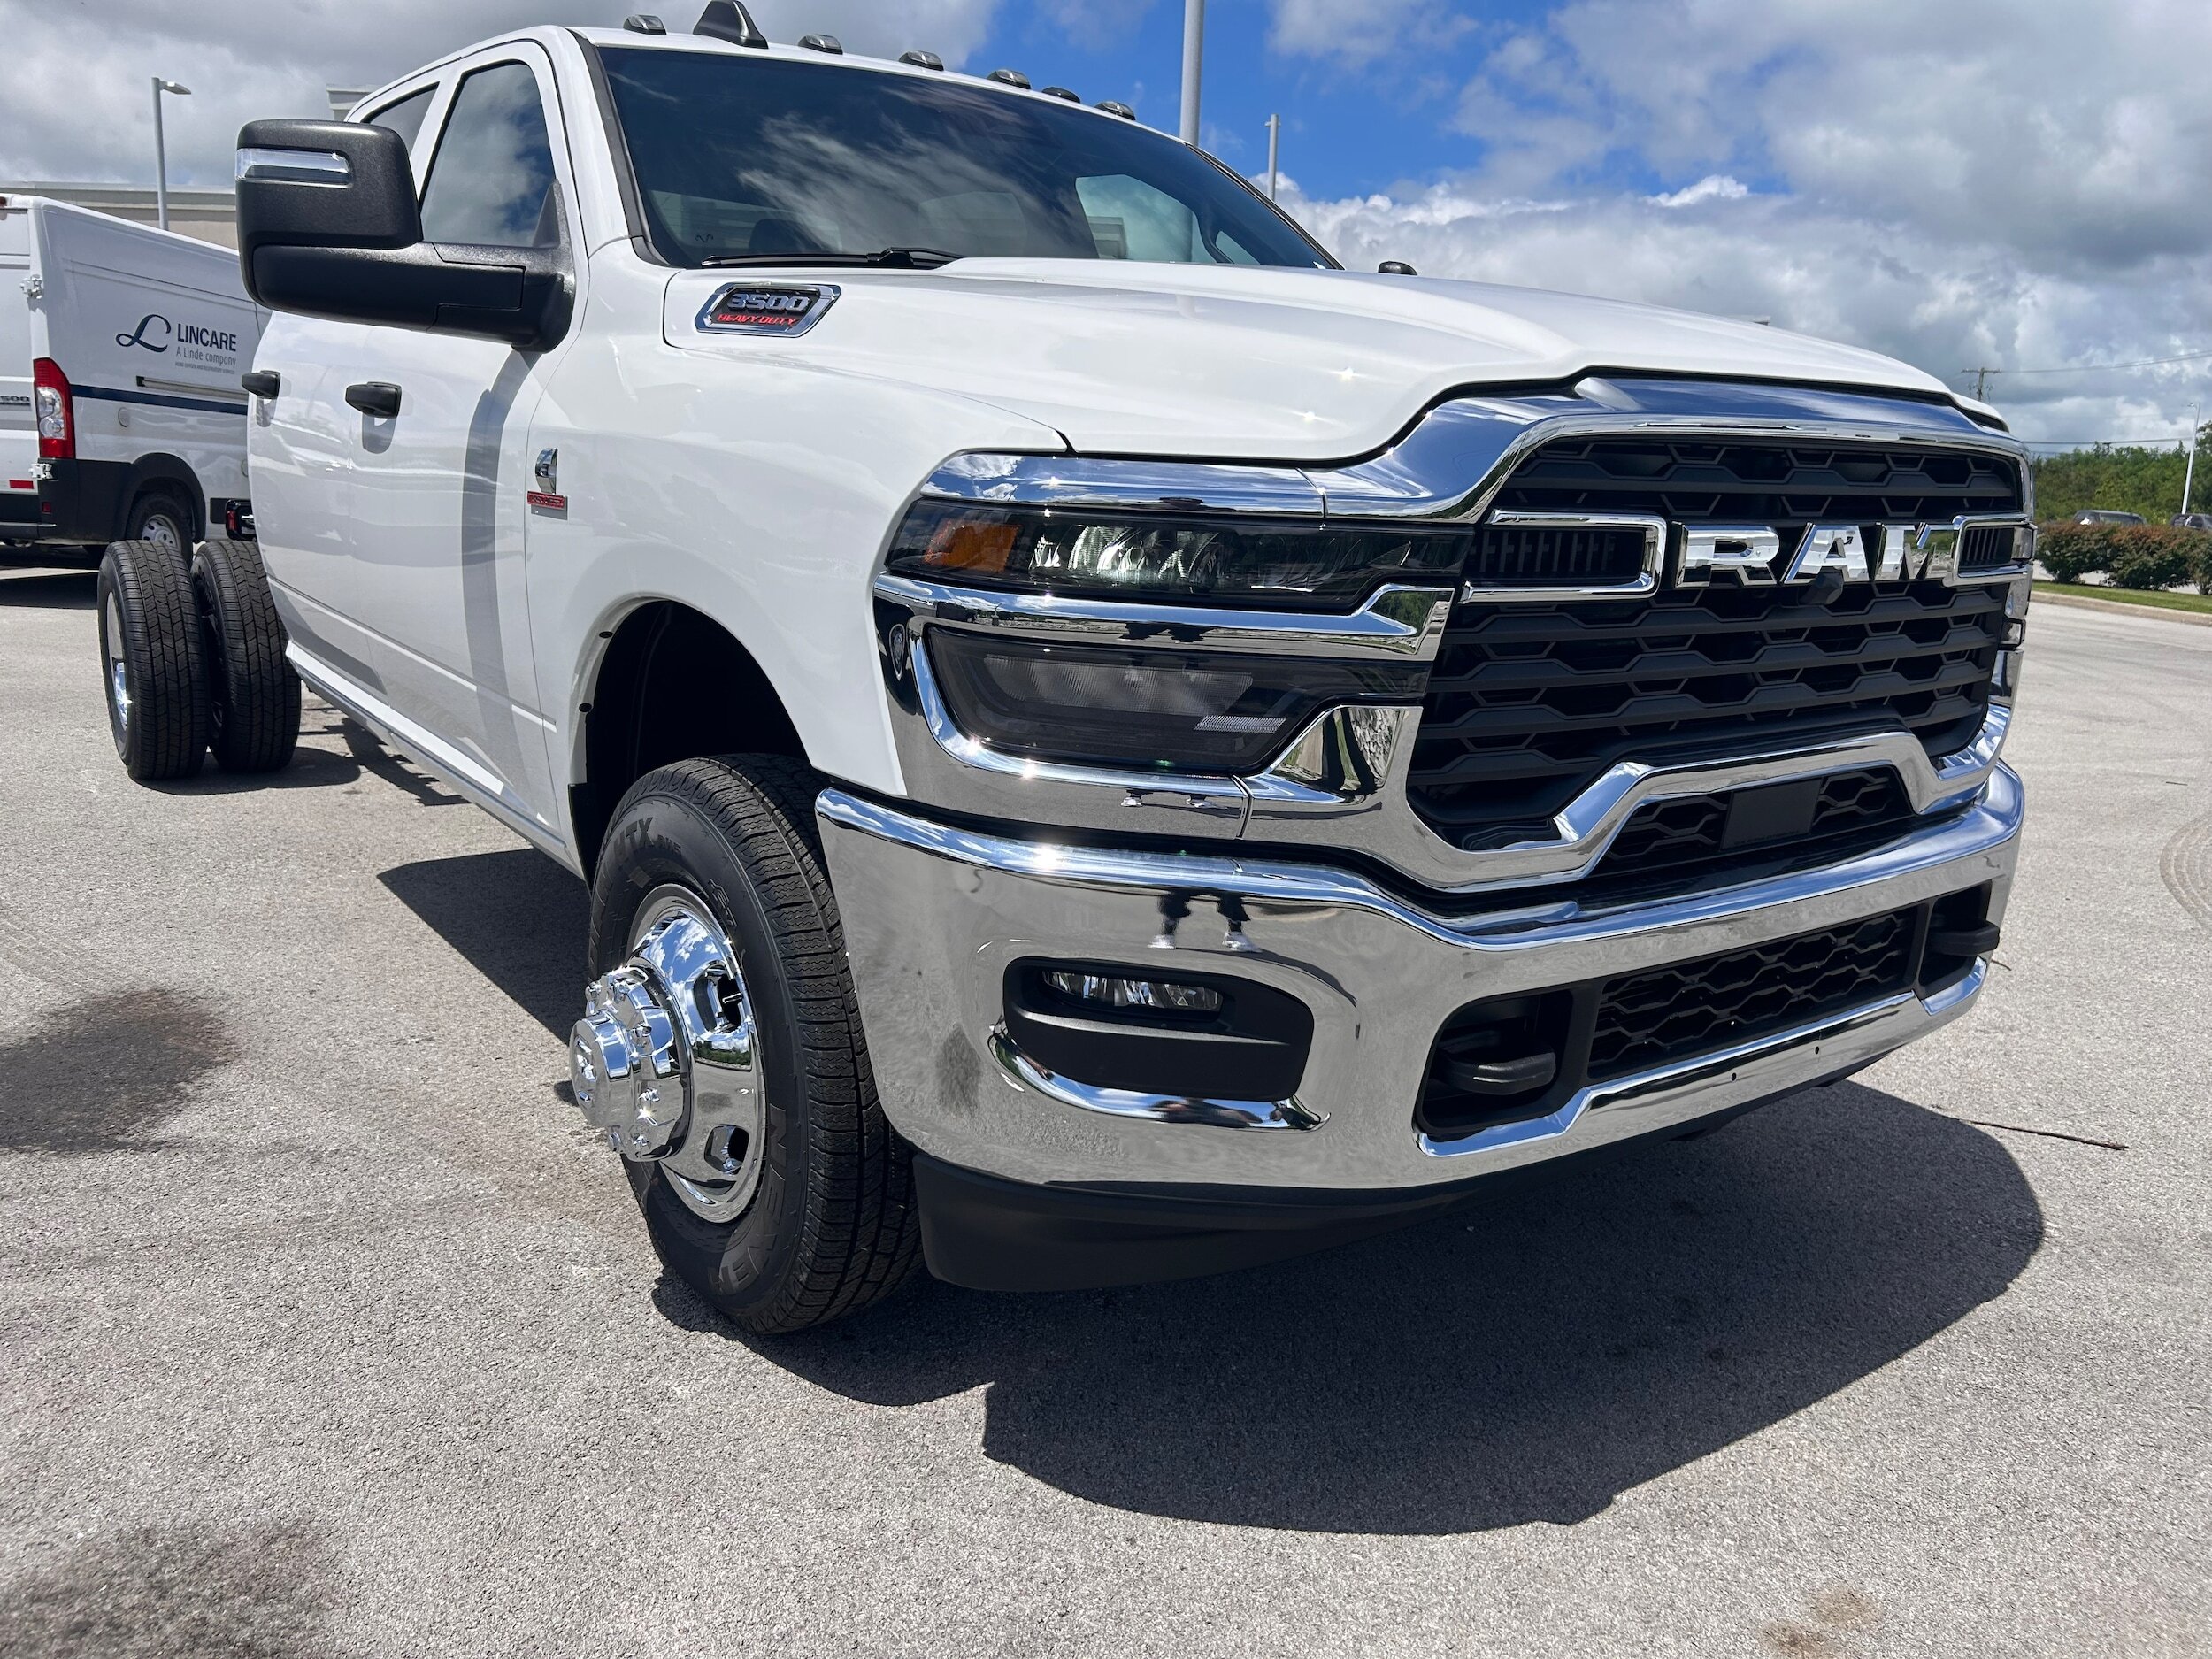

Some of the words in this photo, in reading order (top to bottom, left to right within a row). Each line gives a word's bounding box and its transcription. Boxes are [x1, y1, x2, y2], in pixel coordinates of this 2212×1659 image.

[727, 293, 811, 312] 3500
[717, 313, 758, 324] HEAVY
[758, 316, 798, 326] DUTY
[177, 323, 237, 352] LINCARE
[176, 346, 181, 357] A
[183, 347, 204, 361] Linde
[205, 352, 237, 368] company
[1671, 520, 1955, 588] RAM
